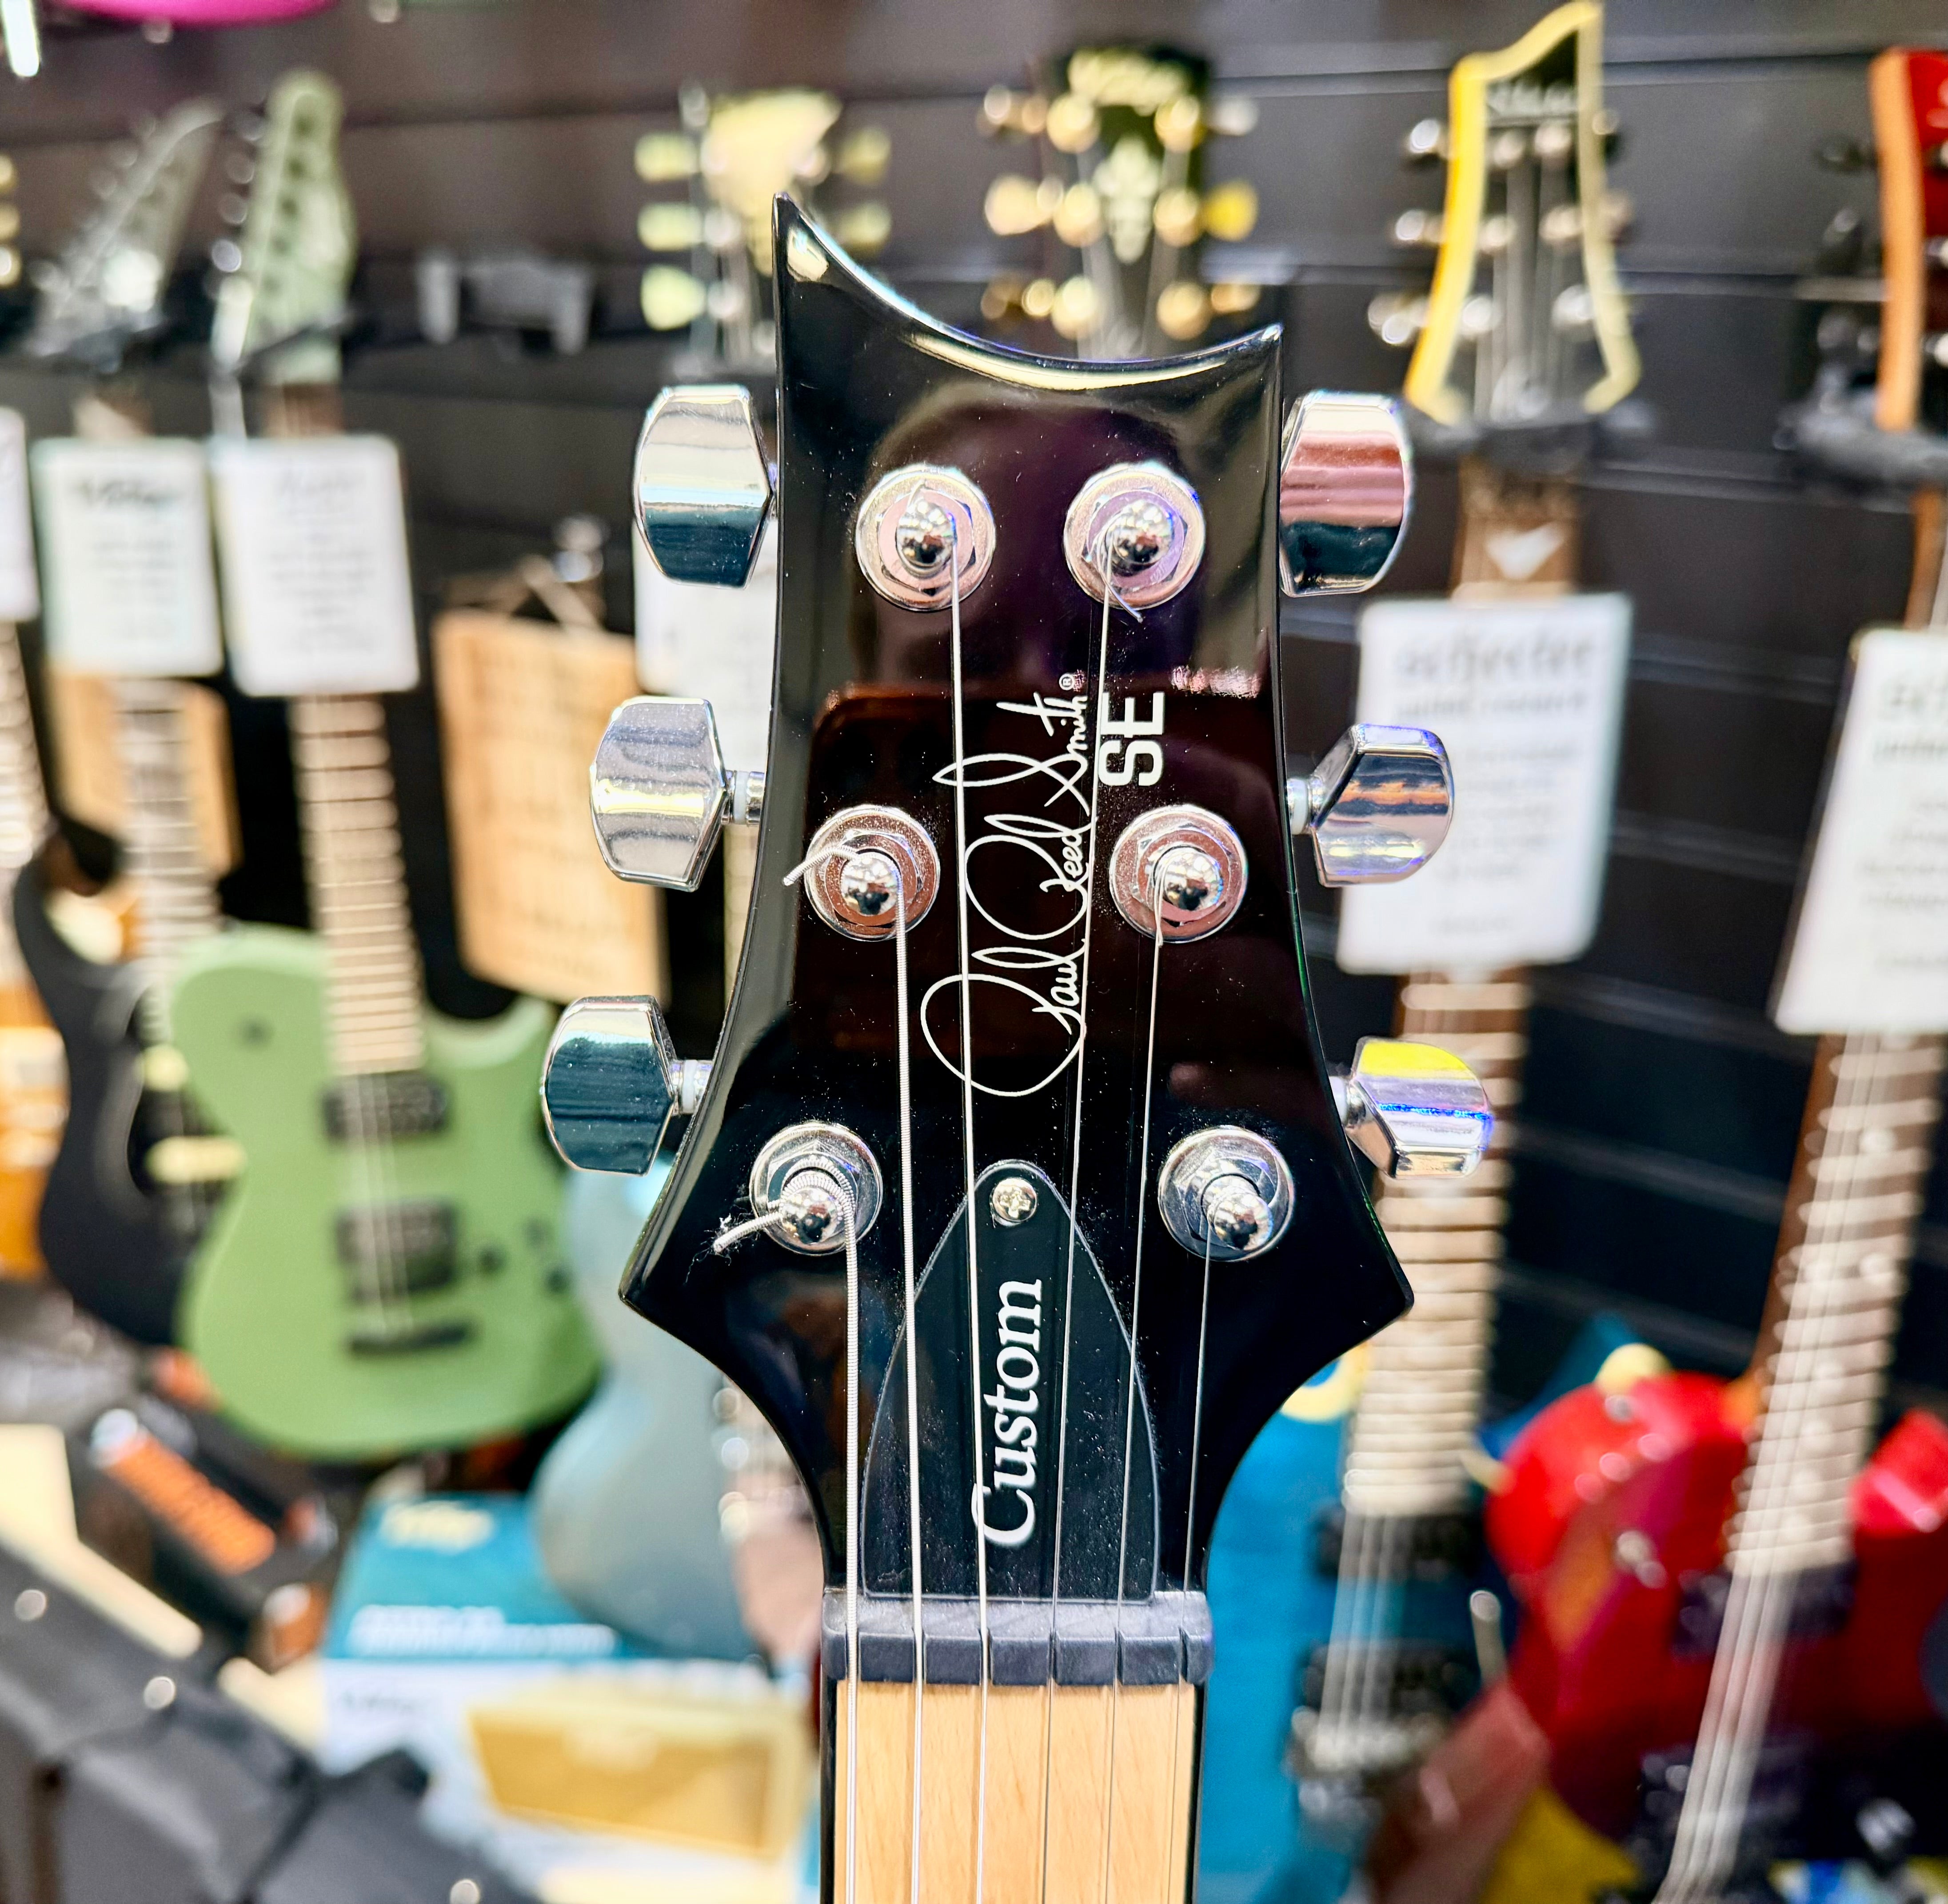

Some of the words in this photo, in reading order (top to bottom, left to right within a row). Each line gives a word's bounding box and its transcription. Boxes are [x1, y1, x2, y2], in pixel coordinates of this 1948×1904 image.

[1098, 692, 1165, 787] SE
[965, 813, 1097, 940] Reed
[920, 938, 1087, 1096] Paul
[971, 1279, 1042, 1547] Custom
